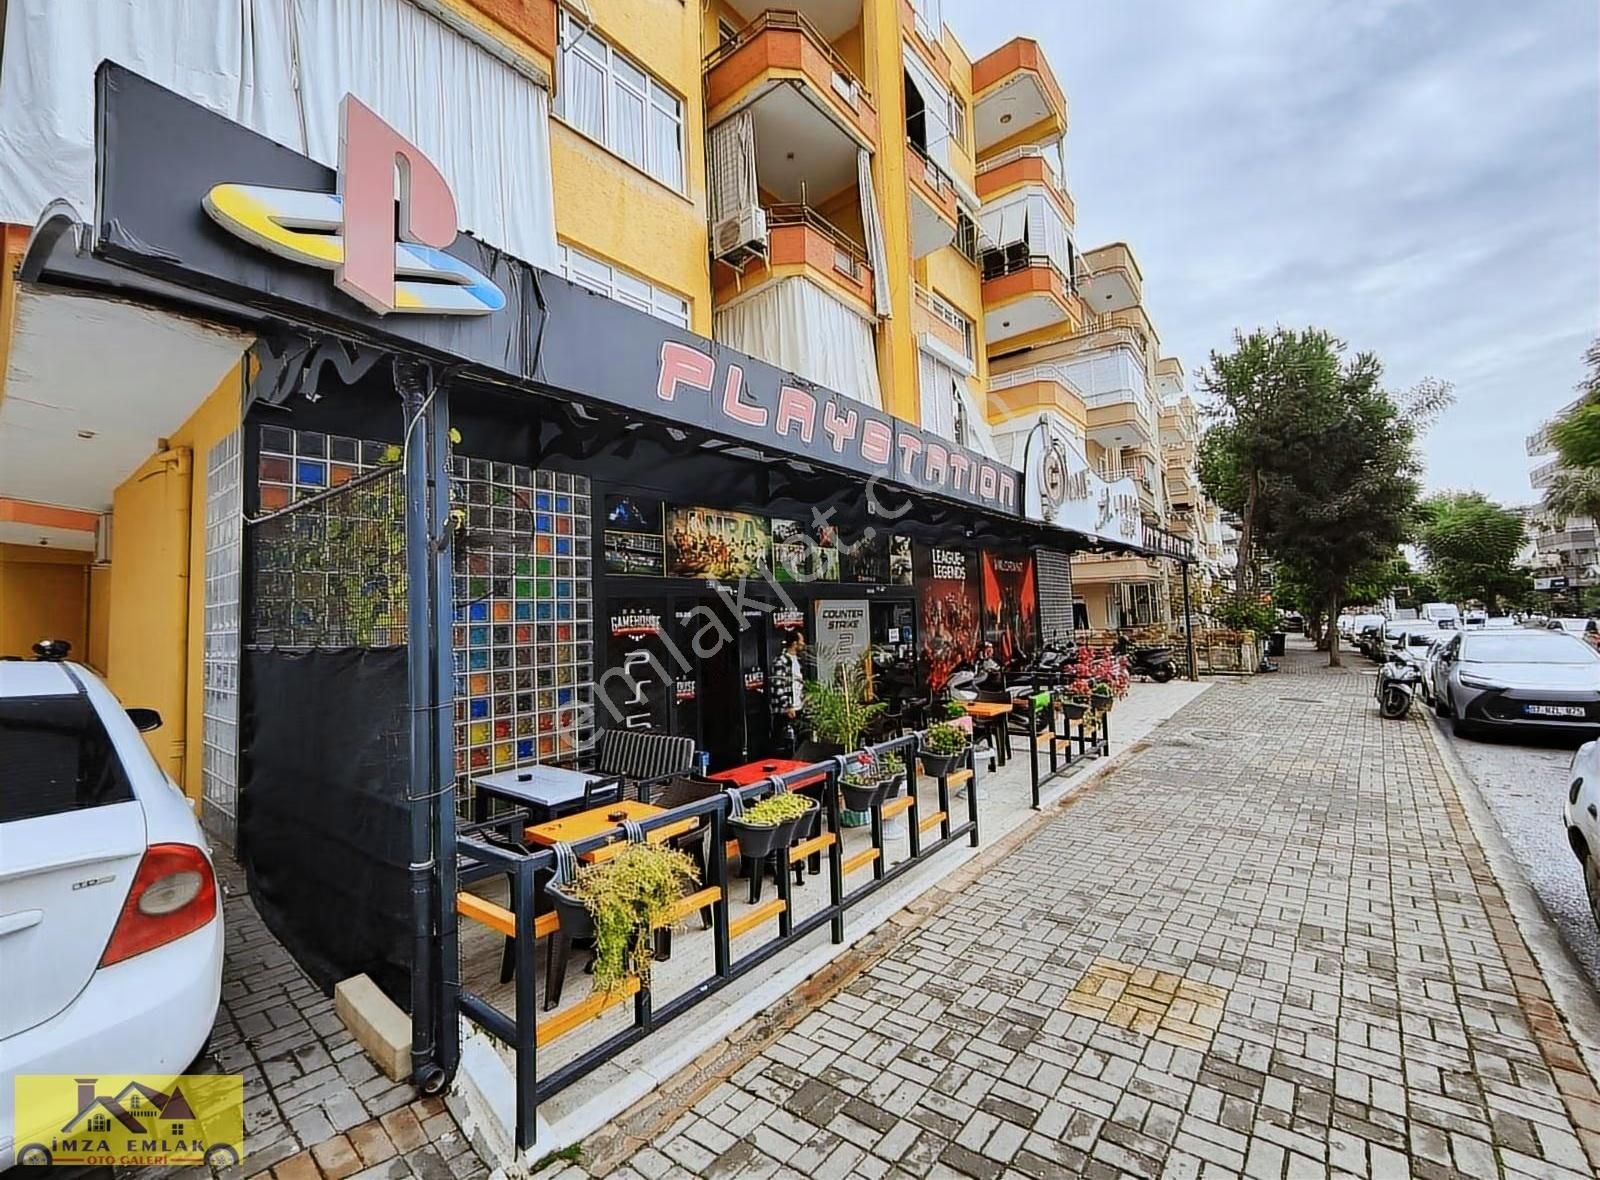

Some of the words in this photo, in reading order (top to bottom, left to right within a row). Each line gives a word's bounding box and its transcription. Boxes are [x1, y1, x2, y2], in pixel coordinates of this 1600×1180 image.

[656, 340, 1015, 507] PLAYSTATION
[932, 548, 960, 566] LEAGUE
[932, 564, 966, 580] LEGENDS
[822, 609, 864, 619] COUNTER
